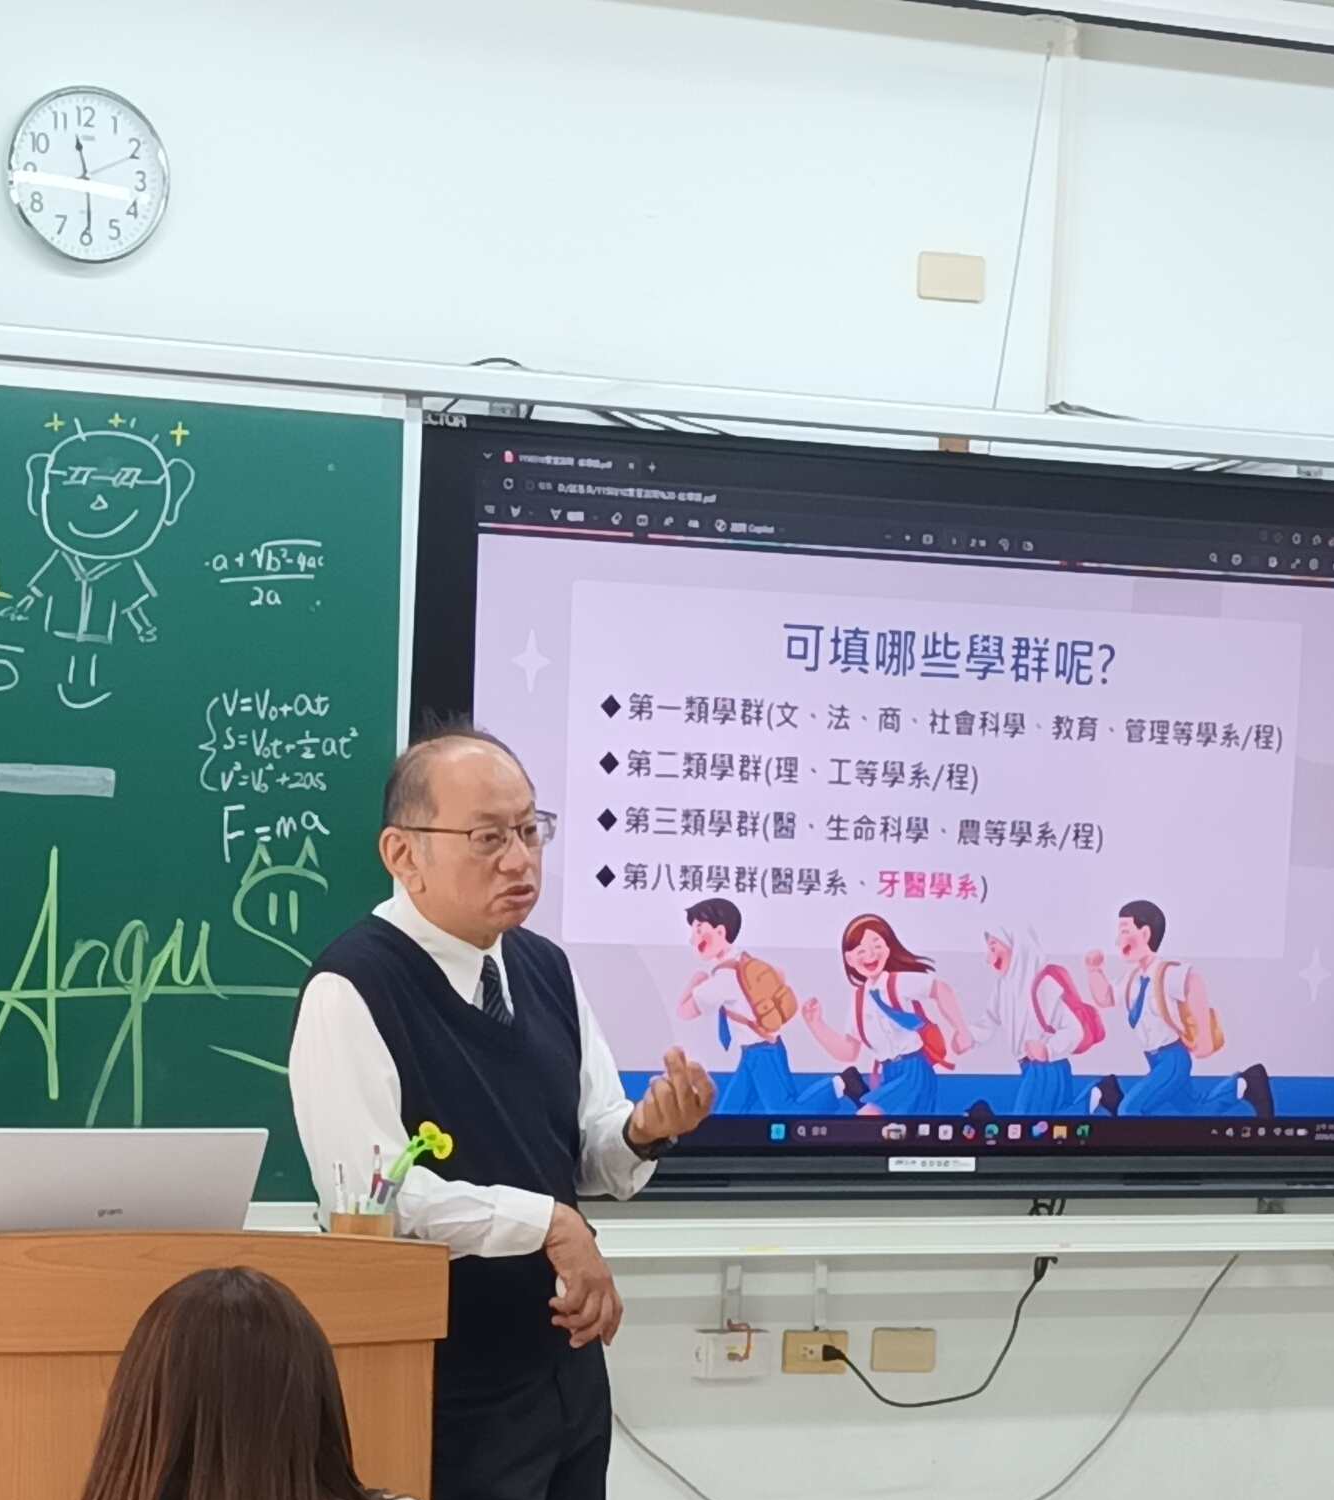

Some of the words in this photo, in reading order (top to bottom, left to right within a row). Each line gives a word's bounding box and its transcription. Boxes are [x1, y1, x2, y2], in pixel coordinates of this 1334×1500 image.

[52, 110, 67, 131] 11
[75, 105, 96, 128] 12
[111, 115, 118, 134] 1
[30, 131, 50, 154] 10
[128, 137, 141, 159] 2
[134, 170, 147, 192] 3
[30, 191, 43, 213] 8
[55, 214, 67, 235] 7
[108, 218, 121, 241] 5
[79, 226, 93, 246] 6
[783, 622, 1117, 687] 可填哪些學群呢?
